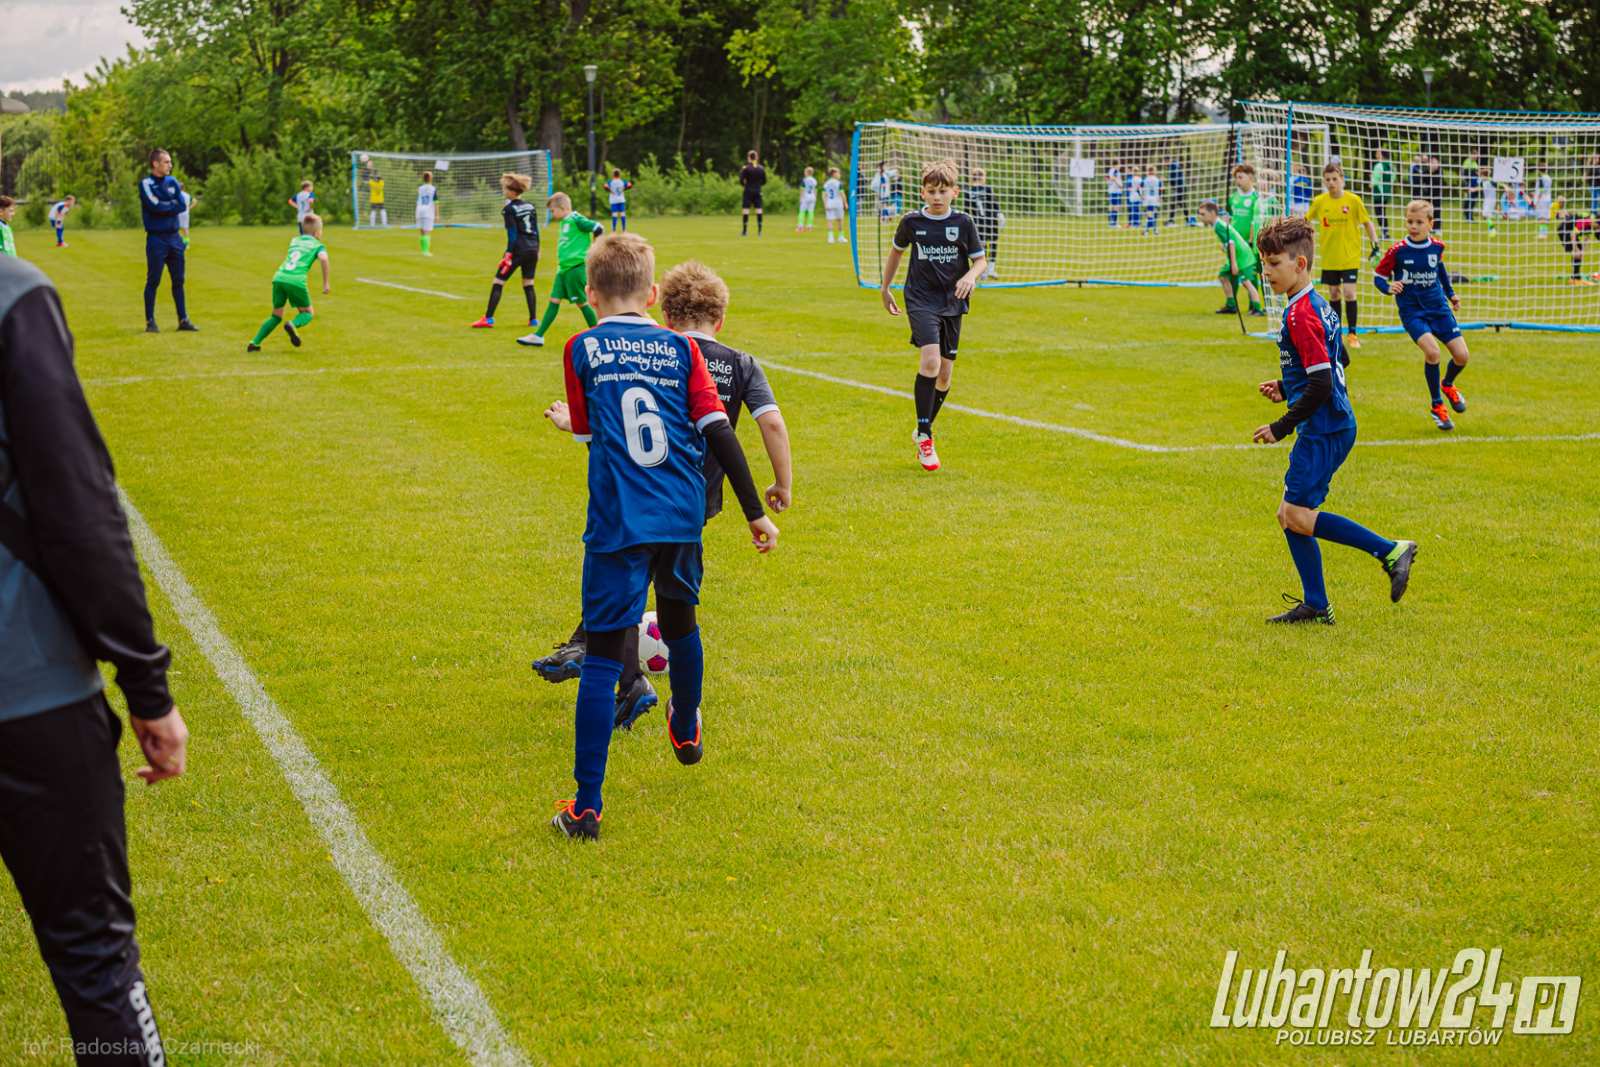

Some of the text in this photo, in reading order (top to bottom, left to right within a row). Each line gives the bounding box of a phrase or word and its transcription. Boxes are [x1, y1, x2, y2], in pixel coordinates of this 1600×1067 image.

[1510, 161, 1520, 180] 5
[604, 337, 678, 358] lubelskie
[618, 353, 651, 371] Smakuj
[621, 386, 669, 468] 6
